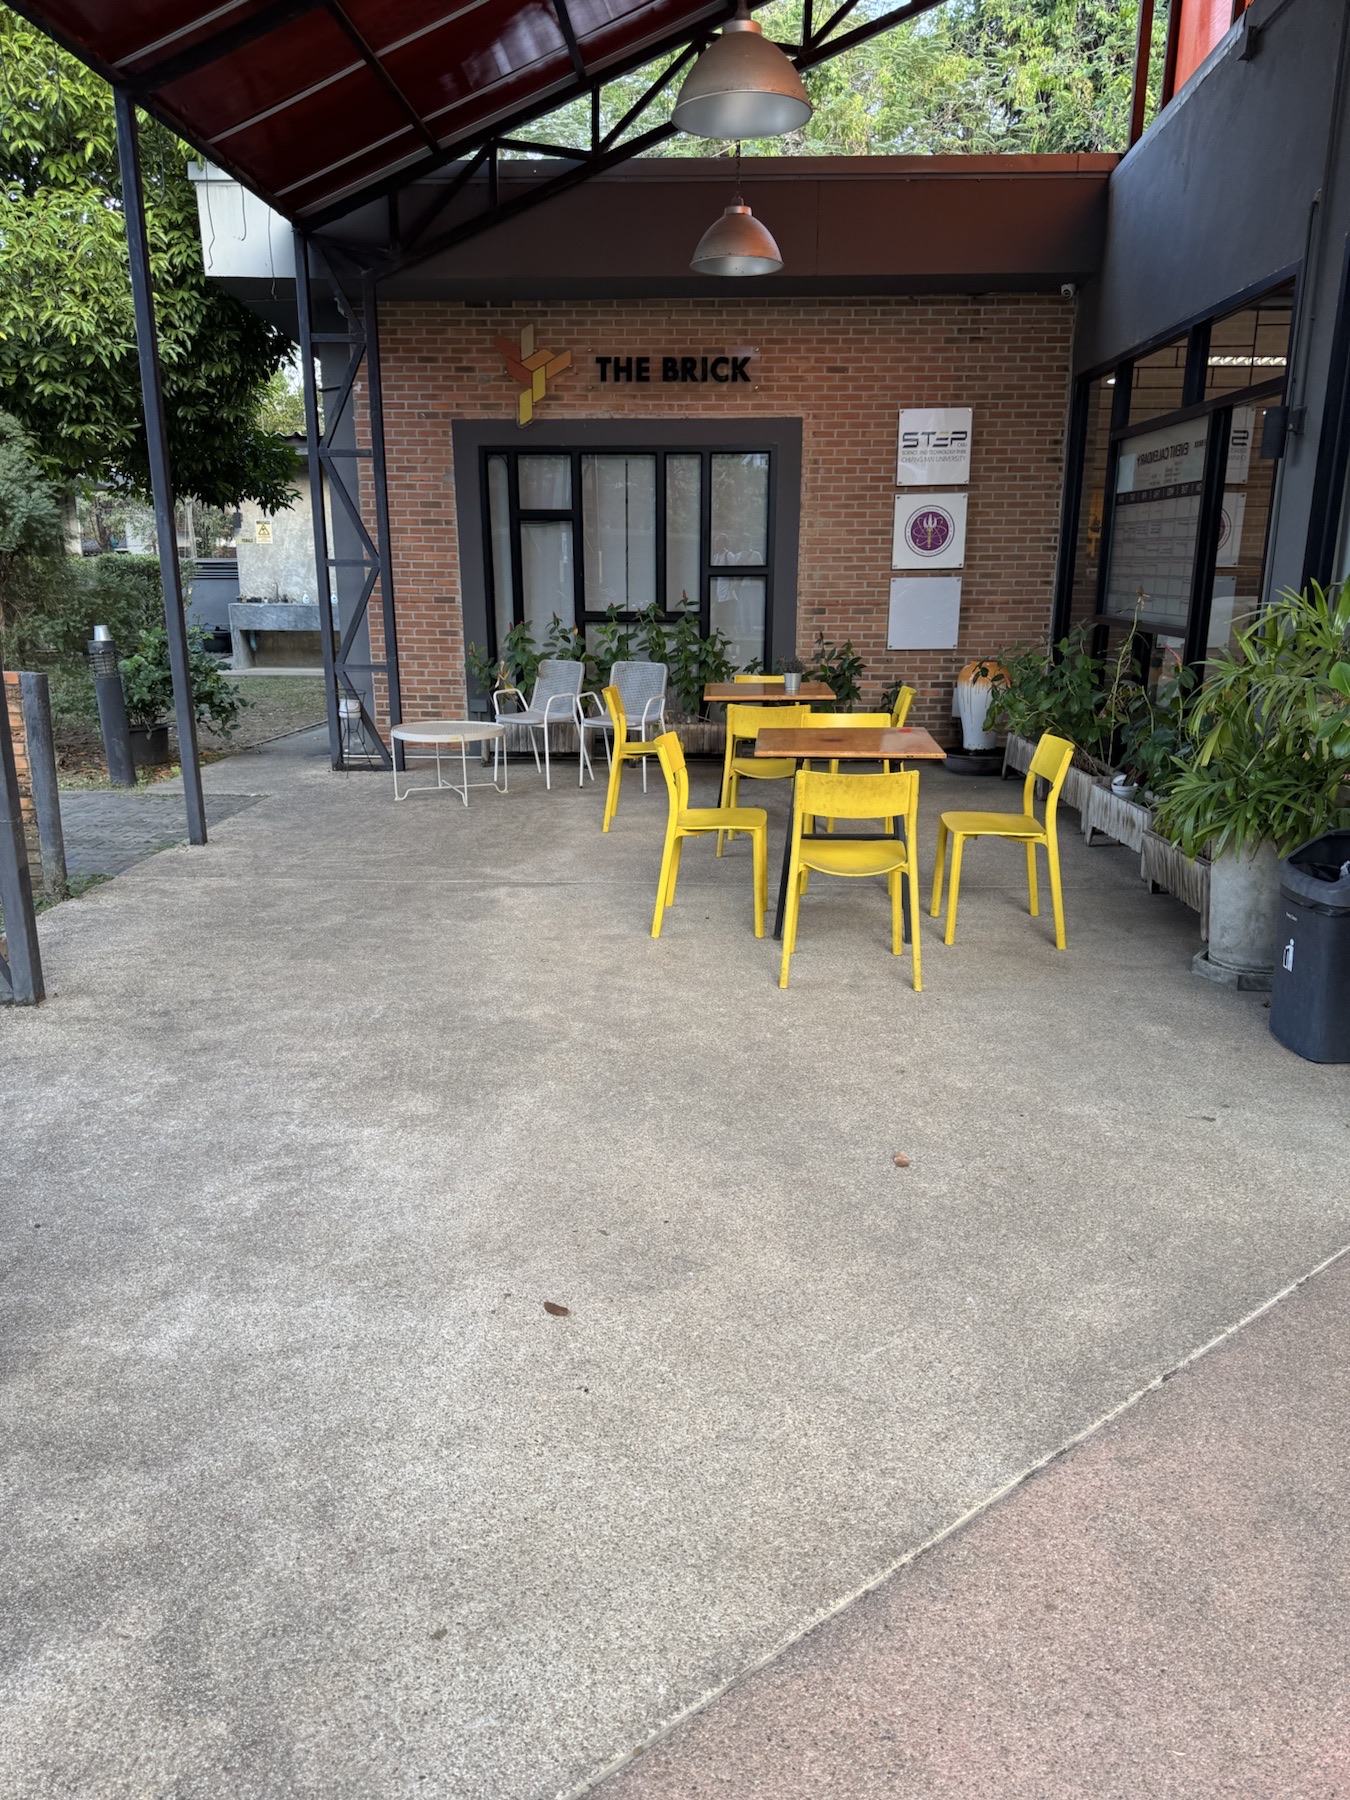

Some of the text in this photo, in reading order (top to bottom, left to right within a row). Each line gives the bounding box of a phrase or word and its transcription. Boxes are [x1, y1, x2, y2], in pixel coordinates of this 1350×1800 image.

[595, 356, 752, 383] THE BRICK
[902, 431, 968, 448] STEP
